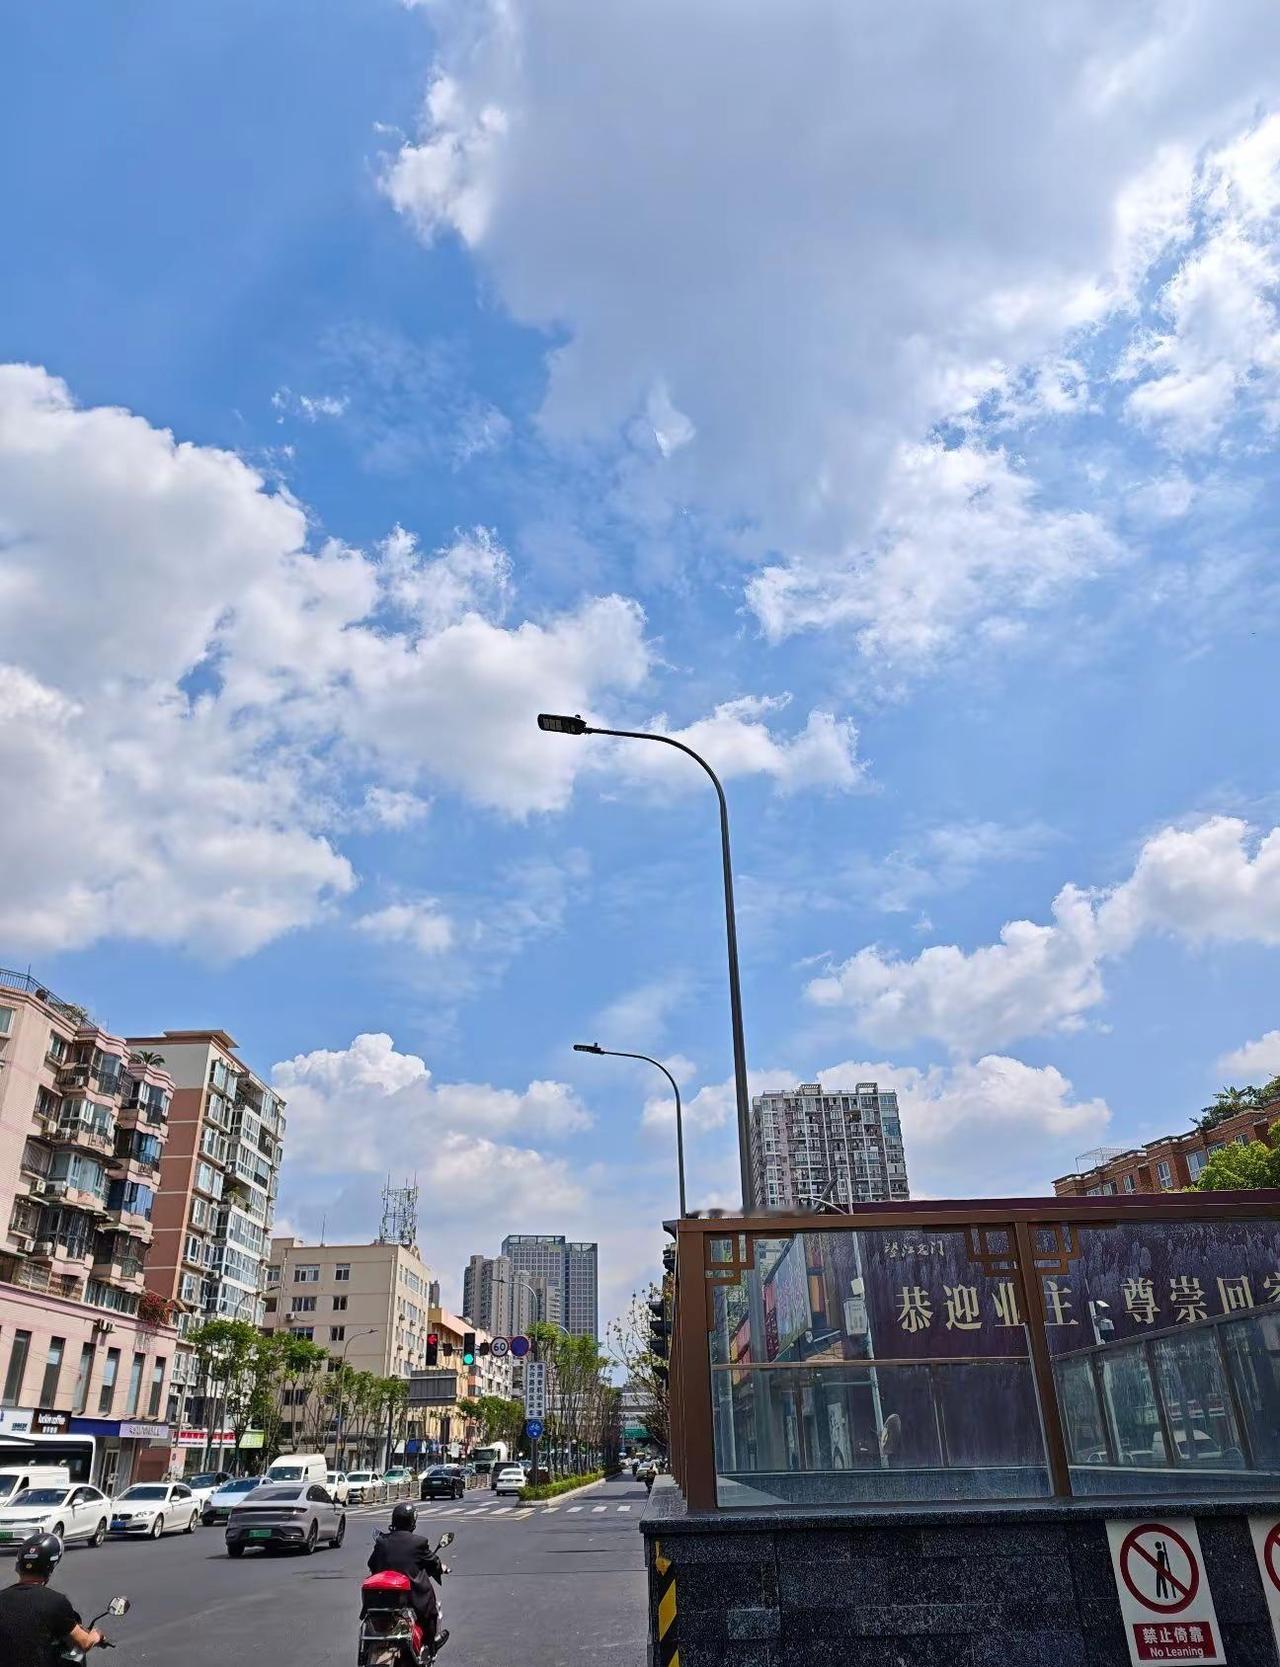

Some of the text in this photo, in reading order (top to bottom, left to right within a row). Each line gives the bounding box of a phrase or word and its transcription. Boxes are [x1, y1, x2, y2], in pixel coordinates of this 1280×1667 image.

[494, 1342, 506, 1352] 60
[1142, 1626, 1204, 1644] 禁止倚靠
[1150, 1645, 1204, 1658] No Leaning
